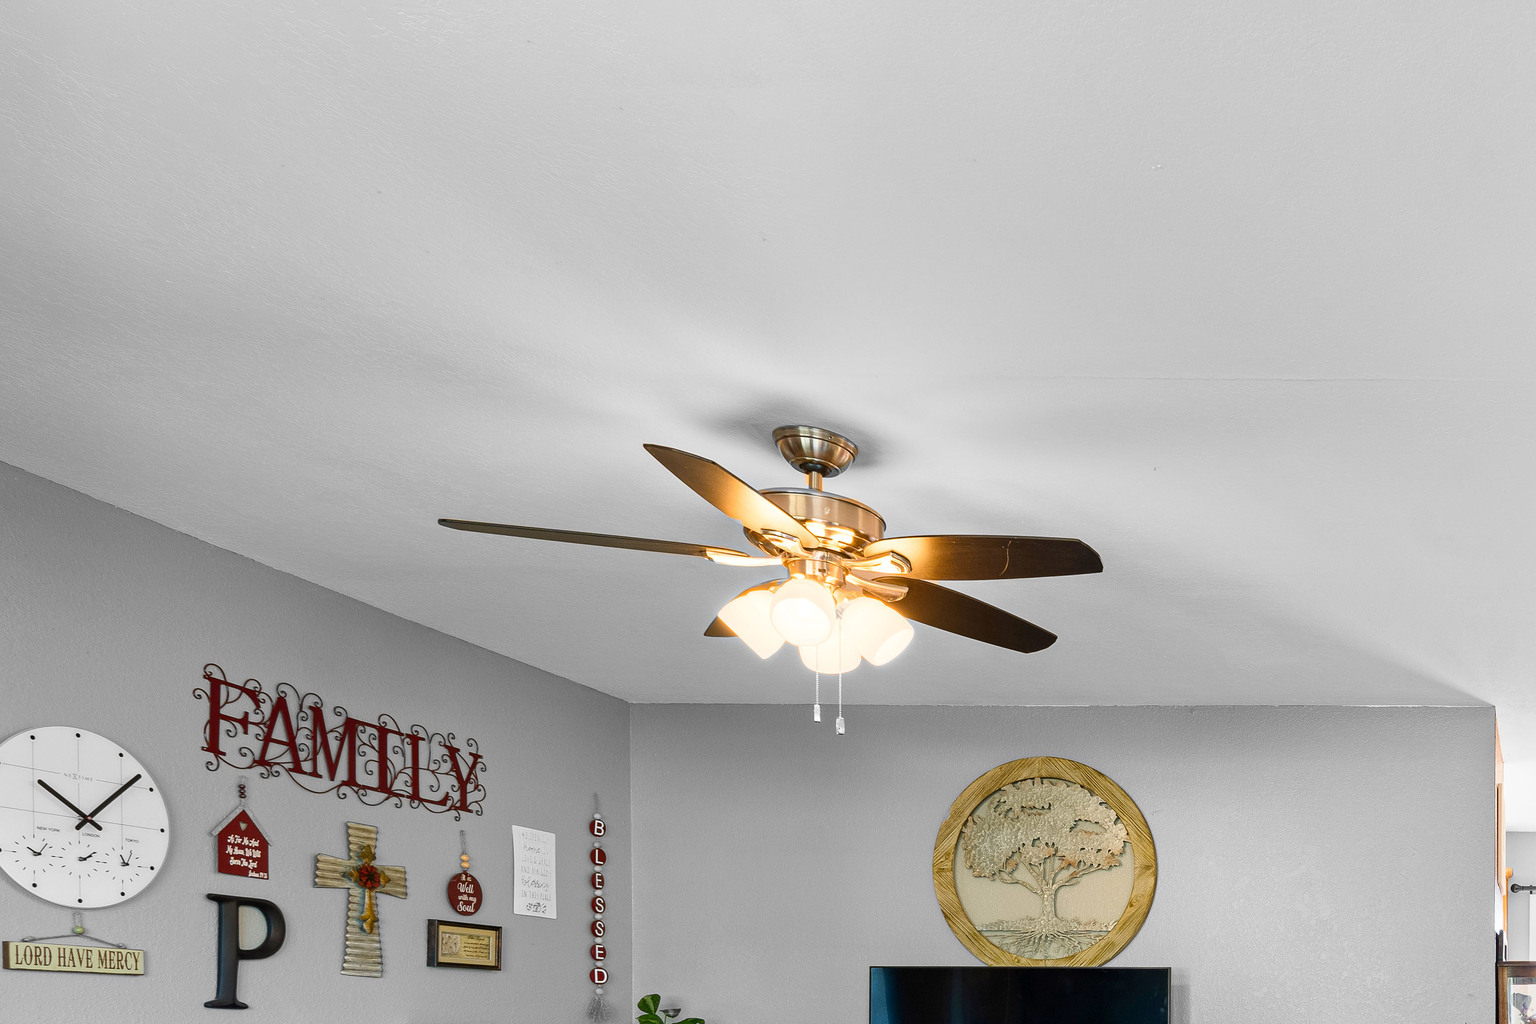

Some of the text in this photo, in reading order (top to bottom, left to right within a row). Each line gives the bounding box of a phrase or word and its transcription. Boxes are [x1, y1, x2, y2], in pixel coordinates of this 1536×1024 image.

[201, 674, 484, 813] FAMILY
[457, 882, 474, 894] Well
[469, 896, 477, 904] my
[593, 819, 608, 984] BLESSED
[457, 901, 475, 912] Soul
[15, 944, 140, 971] LORD HAVE MERCY
[203, 893, 286, 1009] P
